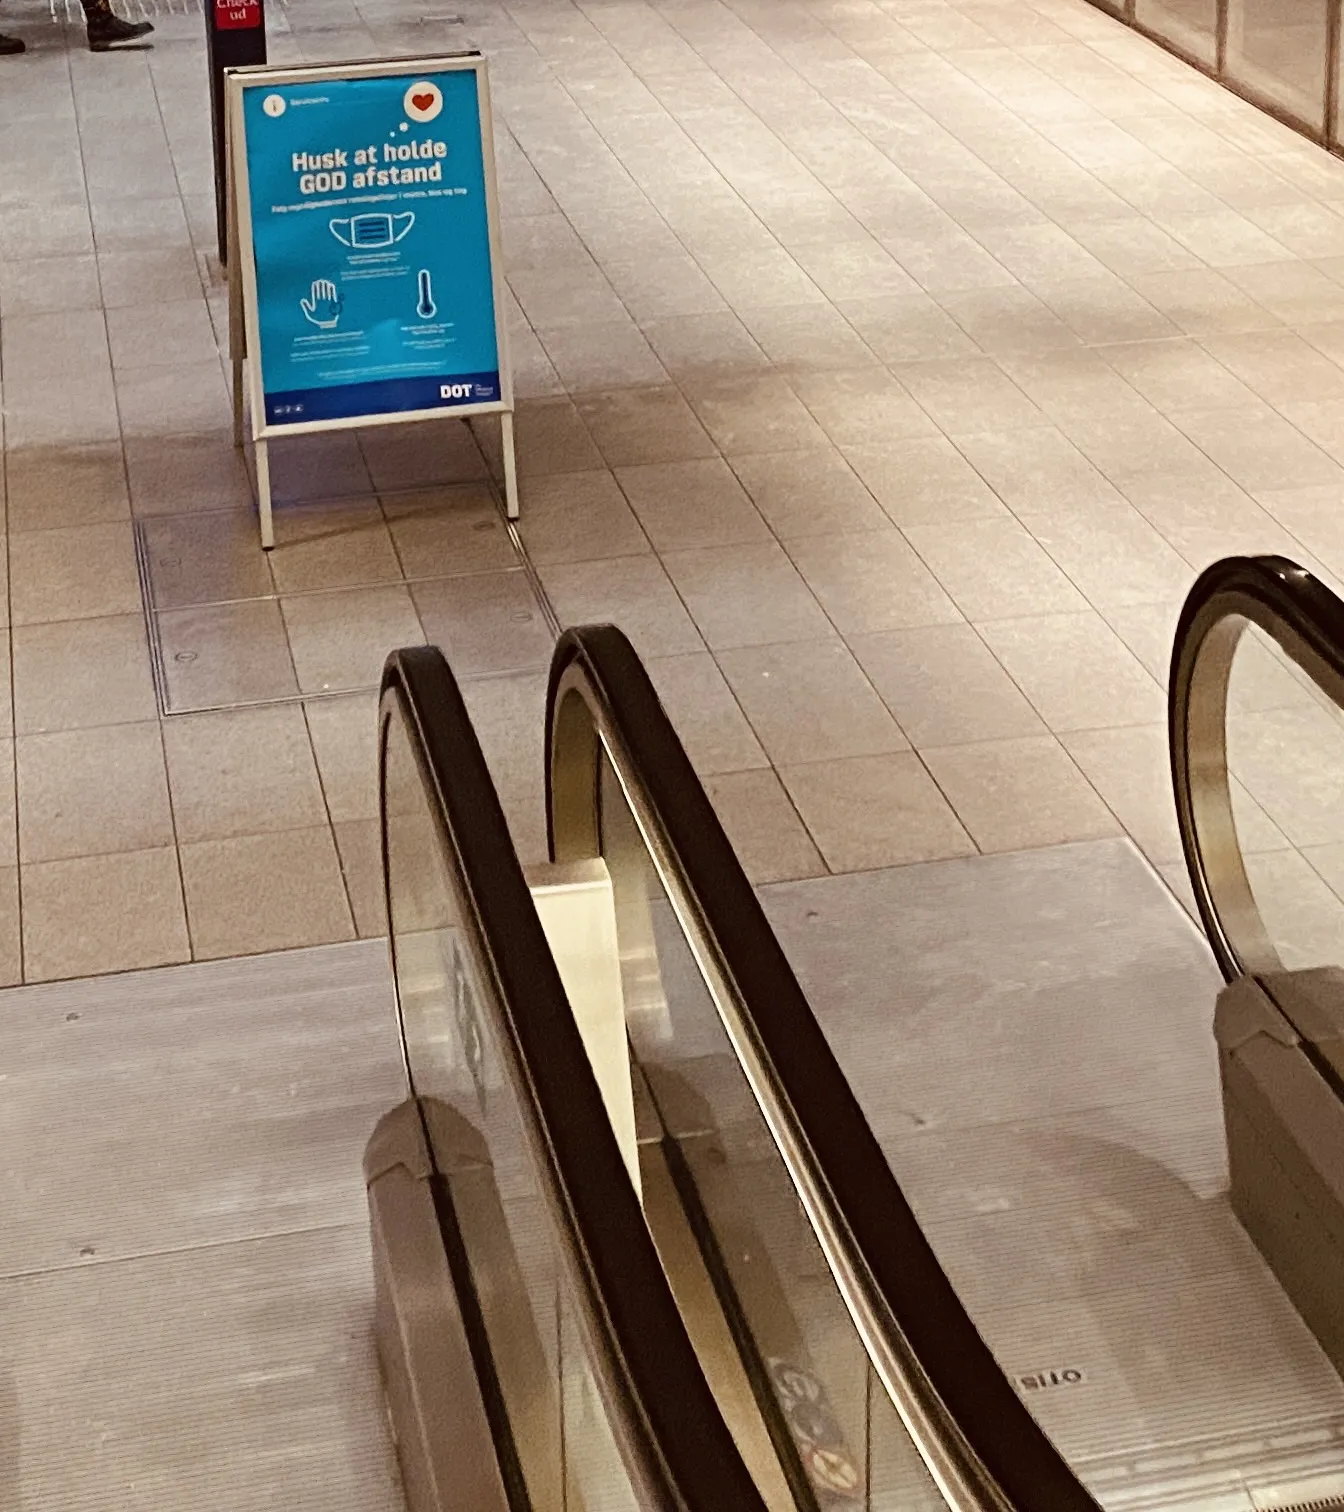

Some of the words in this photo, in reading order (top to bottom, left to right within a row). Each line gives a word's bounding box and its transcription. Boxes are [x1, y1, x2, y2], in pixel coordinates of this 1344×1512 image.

[229, 7, 246, 20] ud
[292, 148, 348, 172] Husk
[353, 146, 378, 166] at
[383, 139, 447, 162] holde
[299, 171, 347, 195] GOD
[352, 162, 442, 188] afstand
[440, 384, 473, 398] DOT
